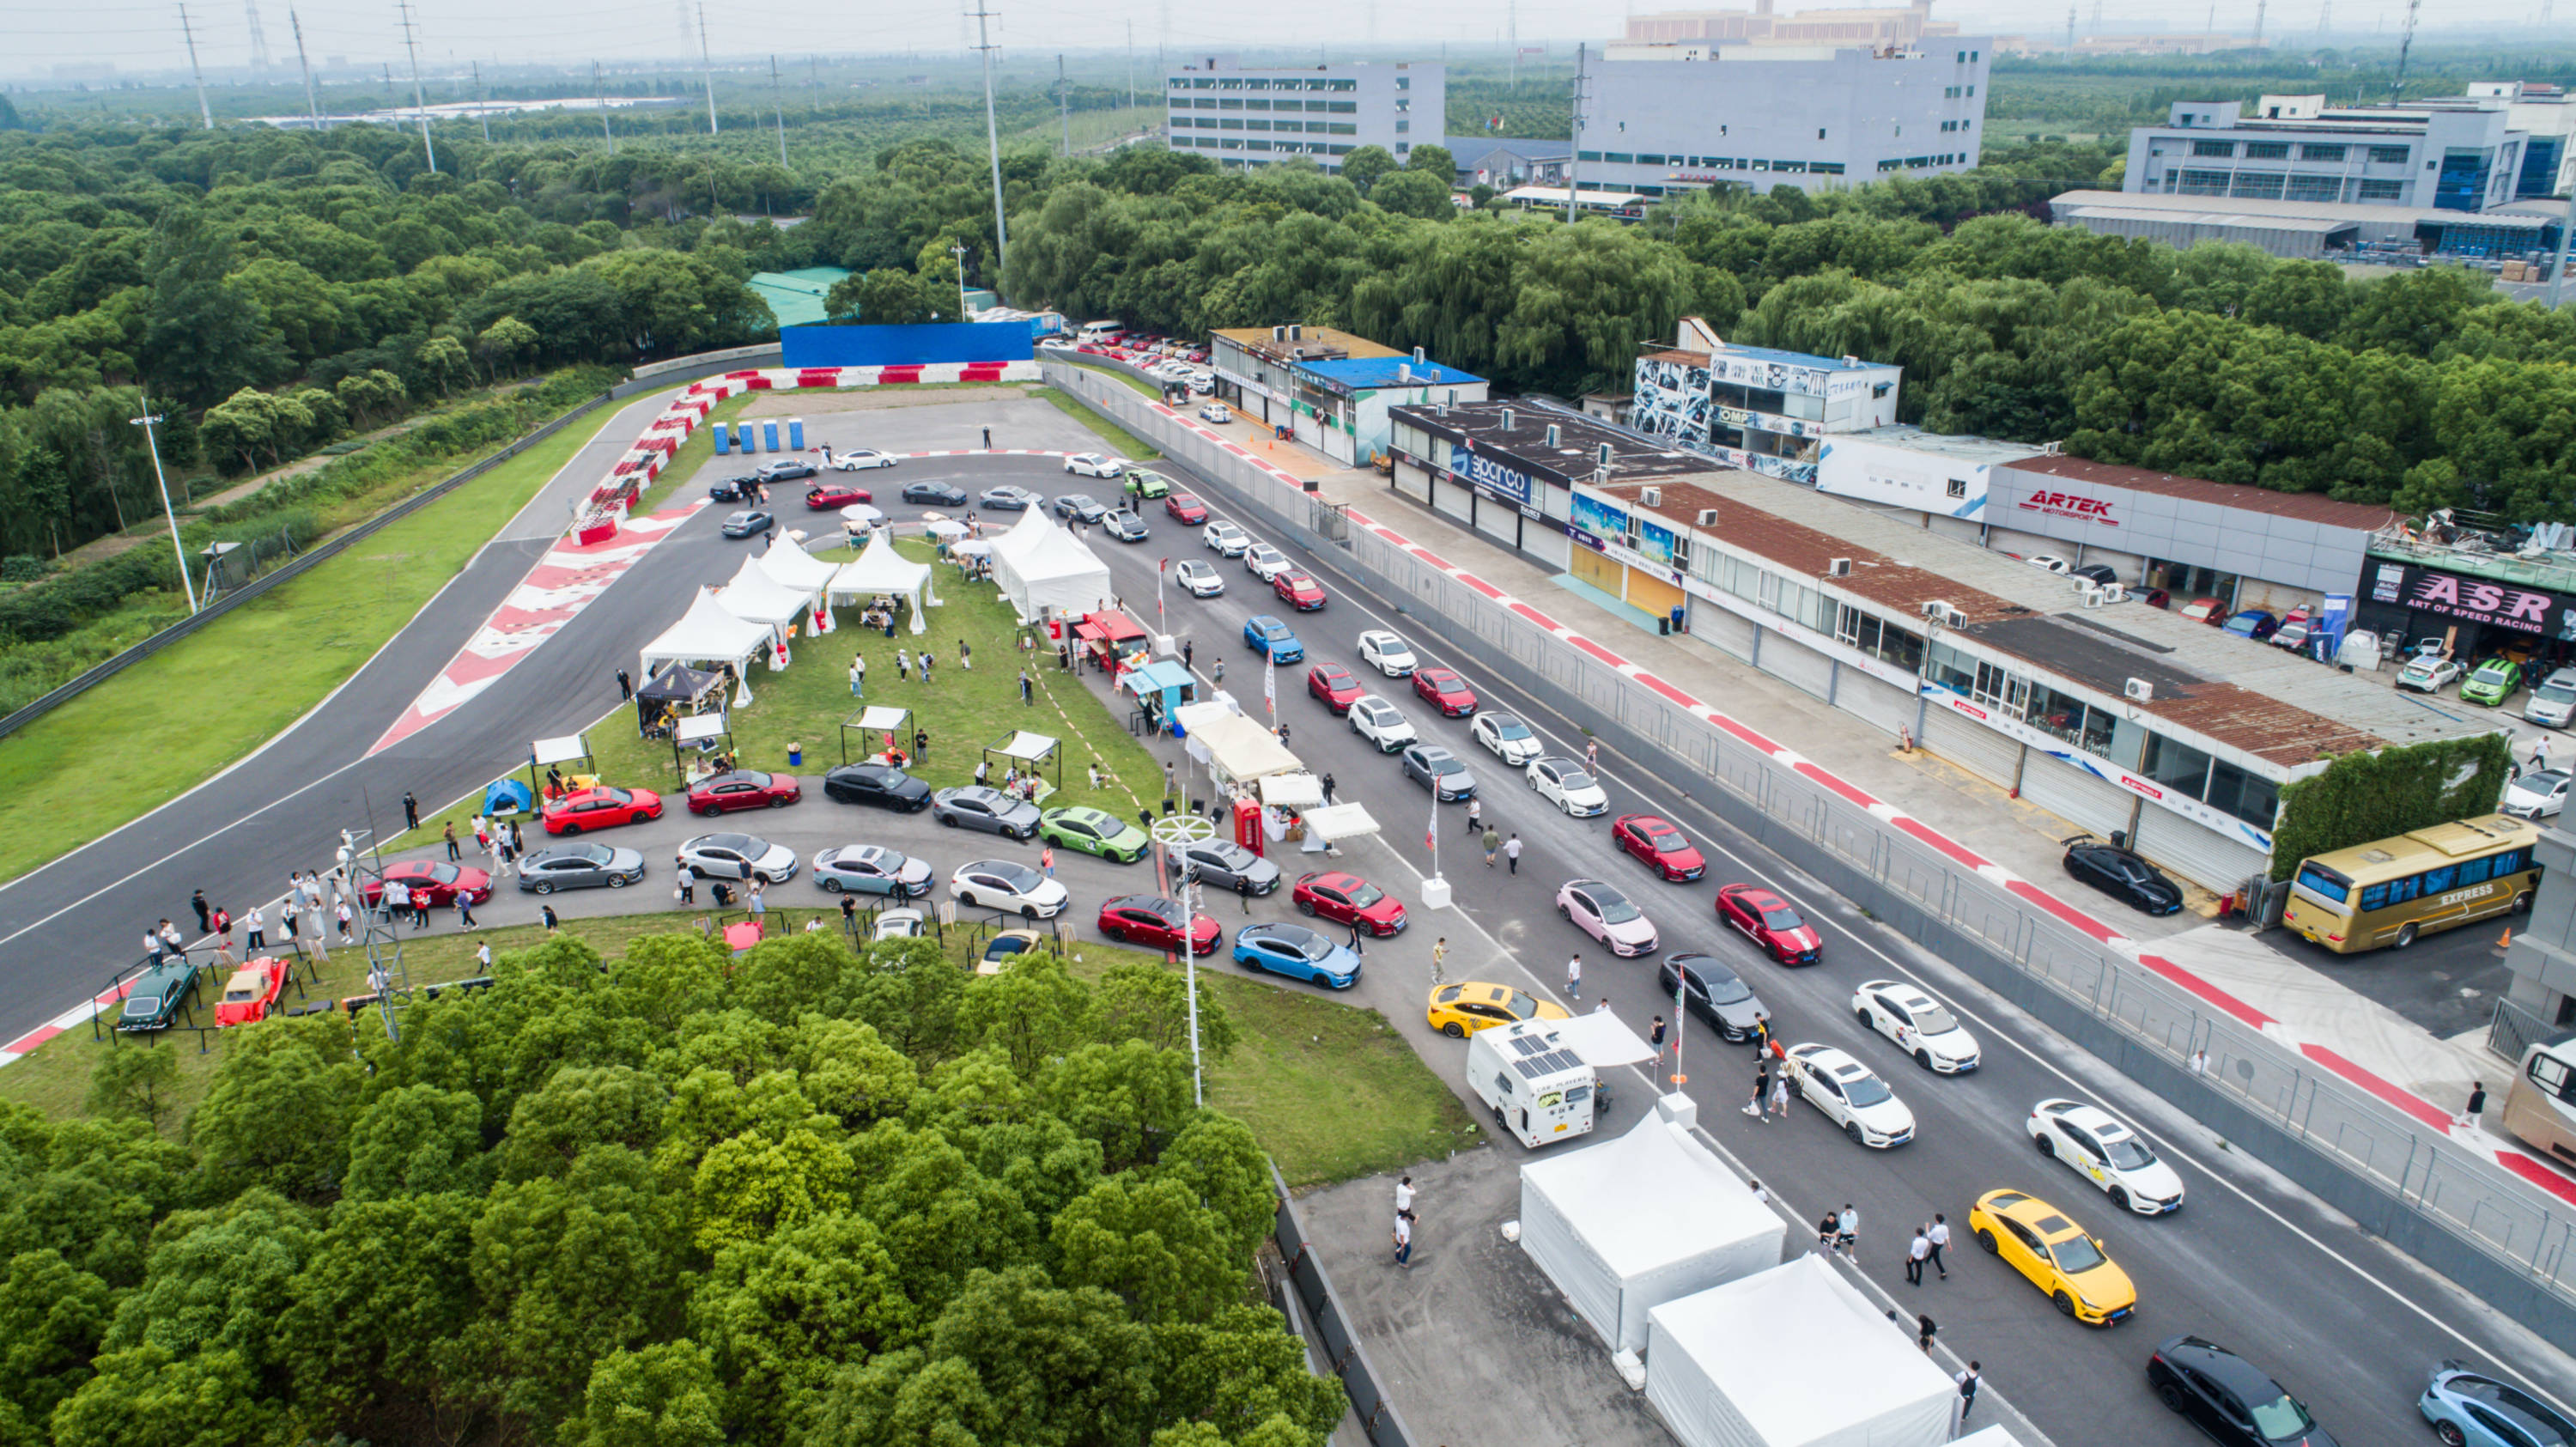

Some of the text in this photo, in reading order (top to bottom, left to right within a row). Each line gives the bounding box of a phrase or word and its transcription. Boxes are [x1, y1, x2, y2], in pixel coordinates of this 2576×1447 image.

[1721, 410, 1748, 424] OMP
[1472, 454, 1525, 492] sparco
[2029, 489, 2115, 516] ARTEK
[2042, 507, 2095, 521] MOTORSPORT
[2419, 575, 2552, 623] ASR
[2407, 599, 2431, 611] ART
[2433, 605, 2450, 614] OF
[2452, 608, 2492, 623] SPEED
[2494, 617, 2543, 633] RACING
[2440, 884, 2494, 905] EXPRESS
